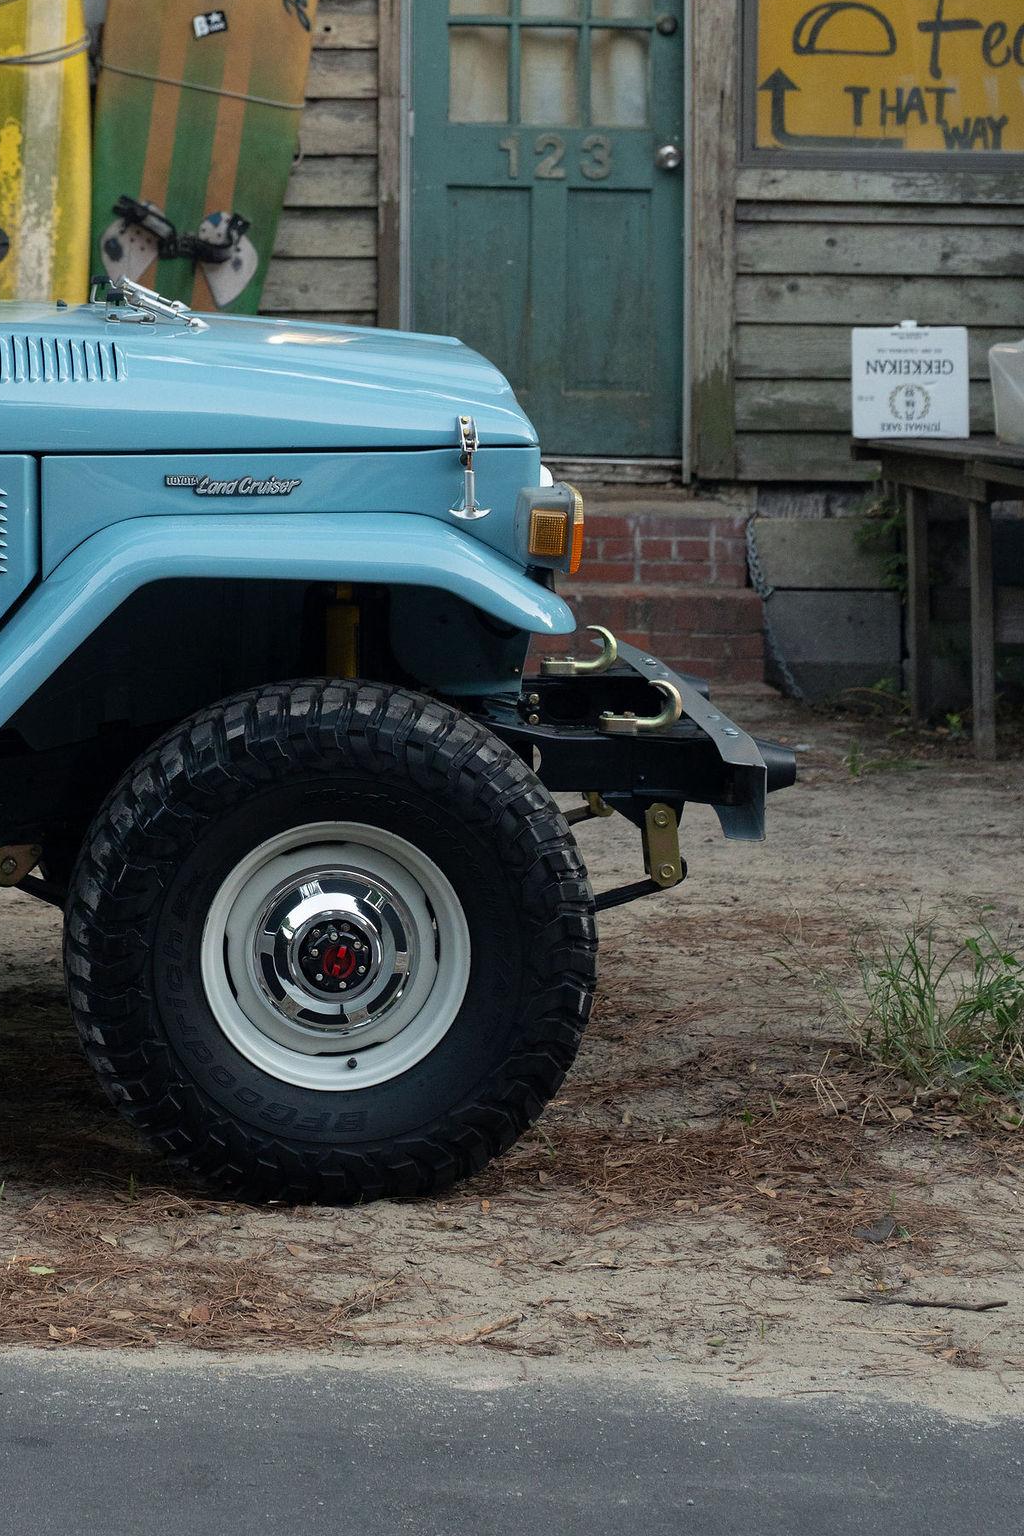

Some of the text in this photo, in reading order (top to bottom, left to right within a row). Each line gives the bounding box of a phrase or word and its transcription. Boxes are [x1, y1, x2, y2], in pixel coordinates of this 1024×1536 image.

[844, 86, 956, 127] THAT
[942, 114, 1009, 150] WAY
[499, 133, 612, 181] 123
[866, 359, 954, 375] GEKKEIKAN
[195, 475, 237, 495] Land
[237, 475, 301, 495] Cruiser
